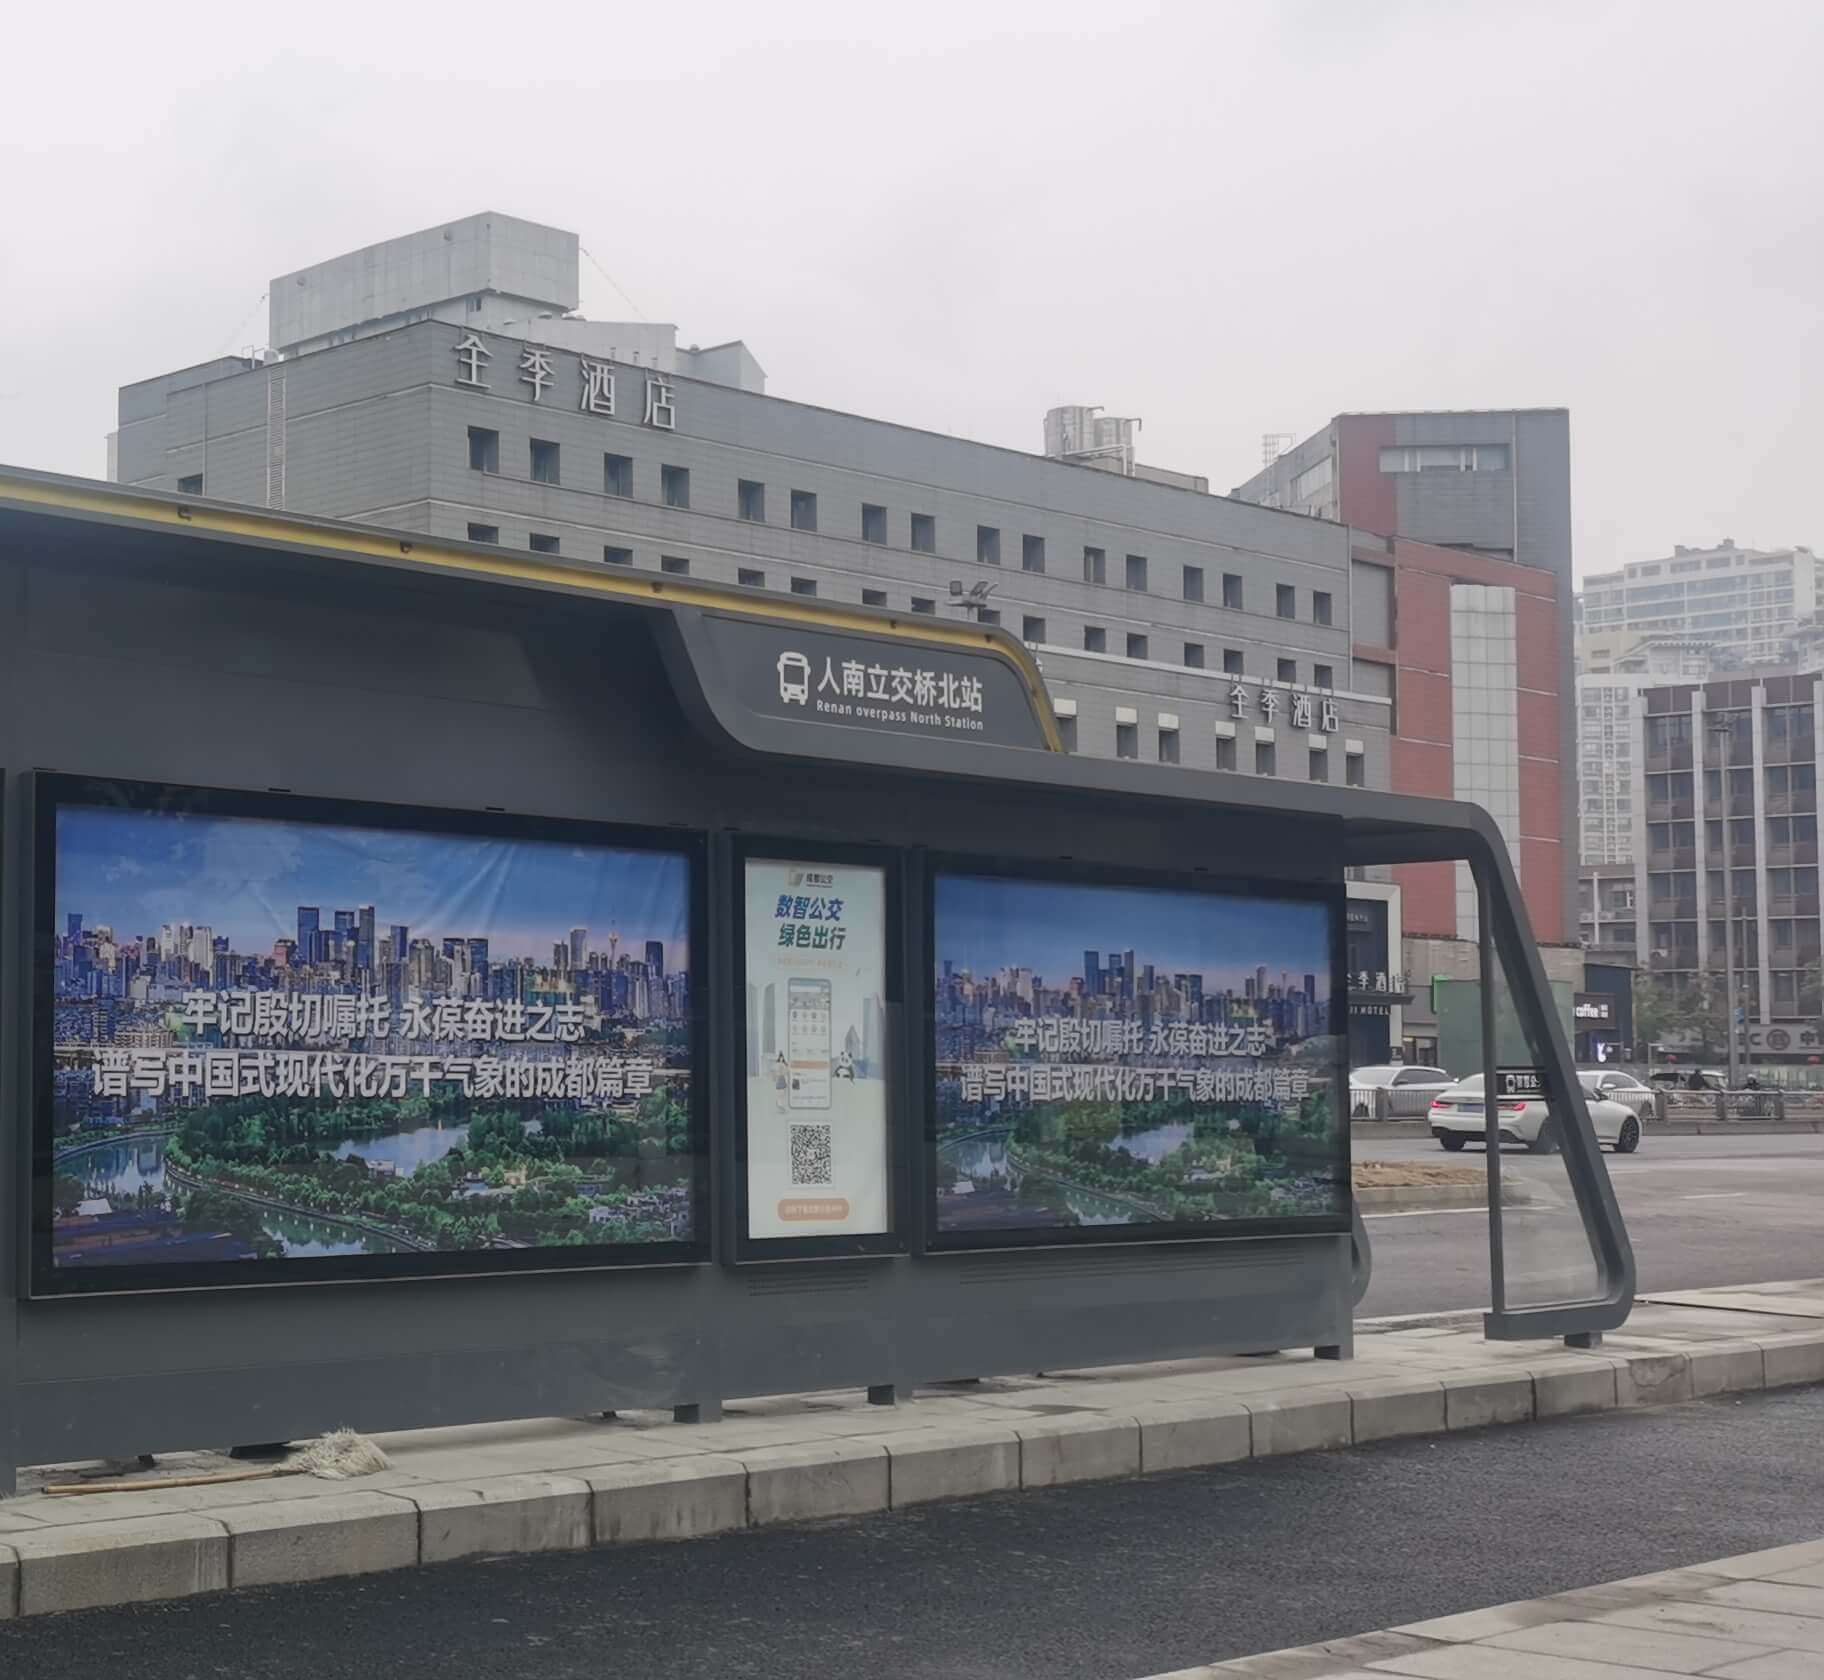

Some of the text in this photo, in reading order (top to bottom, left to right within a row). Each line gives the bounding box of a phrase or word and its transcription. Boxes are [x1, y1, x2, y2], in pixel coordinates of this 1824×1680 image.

[455, 335, 676, 430] 全季酒店
[817, 656, 983, 713] 人南立交桥北站
[816, 699, 984, 731] Renan overpass North Station
[1230, 684, 1339, 733] 全季酒店
[775, 894, 845, 922] 数智公交
[778, 922, 847, 951] 绿色出行
[182, 988, 585, 1042] 牢记殷切嘱托 永葆奋进之志
[1360, 1005, 1392, 1016] HOTEL
[1014, 1016, 1268, 1058] 牢记殷切嘱托 永葆奋进之志
[92, 1048, 653, 1099] 谱写中国式现代化万千气象的成都篇章
[961, 1063, 1310, 1103] 谱写中国式现代化万千气象的成都篇章
